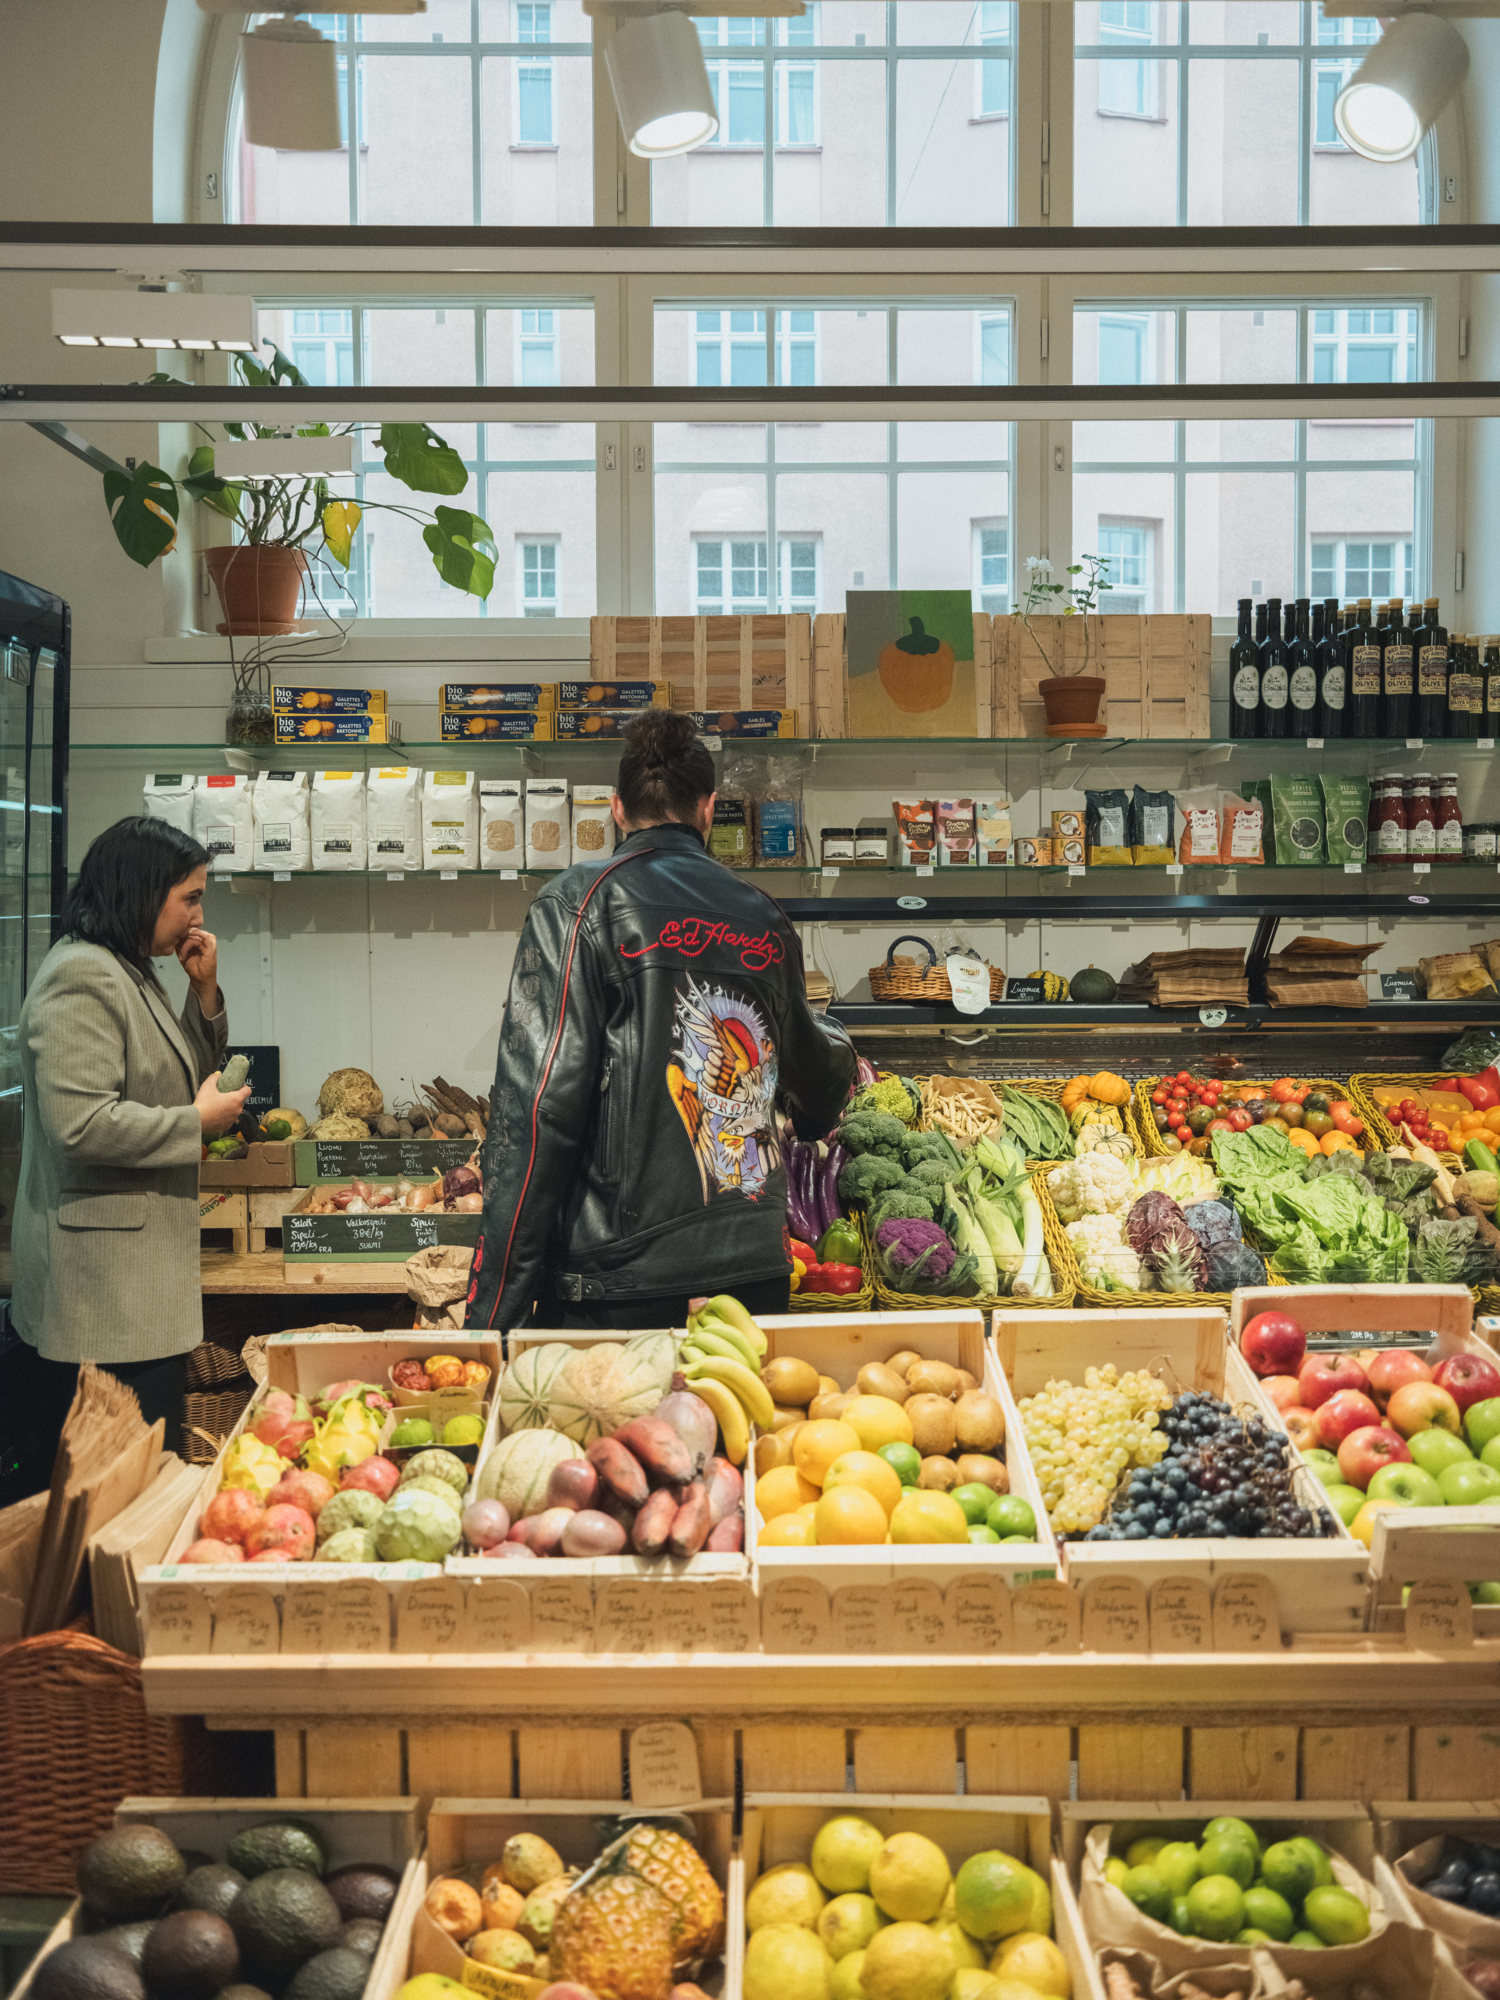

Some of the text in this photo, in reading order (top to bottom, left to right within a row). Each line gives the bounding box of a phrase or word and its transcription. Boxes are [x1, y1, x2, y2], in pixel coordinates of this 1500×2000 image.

[448, 685, 462, 693] bio
[562, 683, 577, 691] bio
[276, 688, 291, 696] bio
[279, 717, 294, 725] bio
[444, 715, 459, 724] bio
[560, 713, 574, 722] bio
[700, 1088, 741, 1116] BORN
